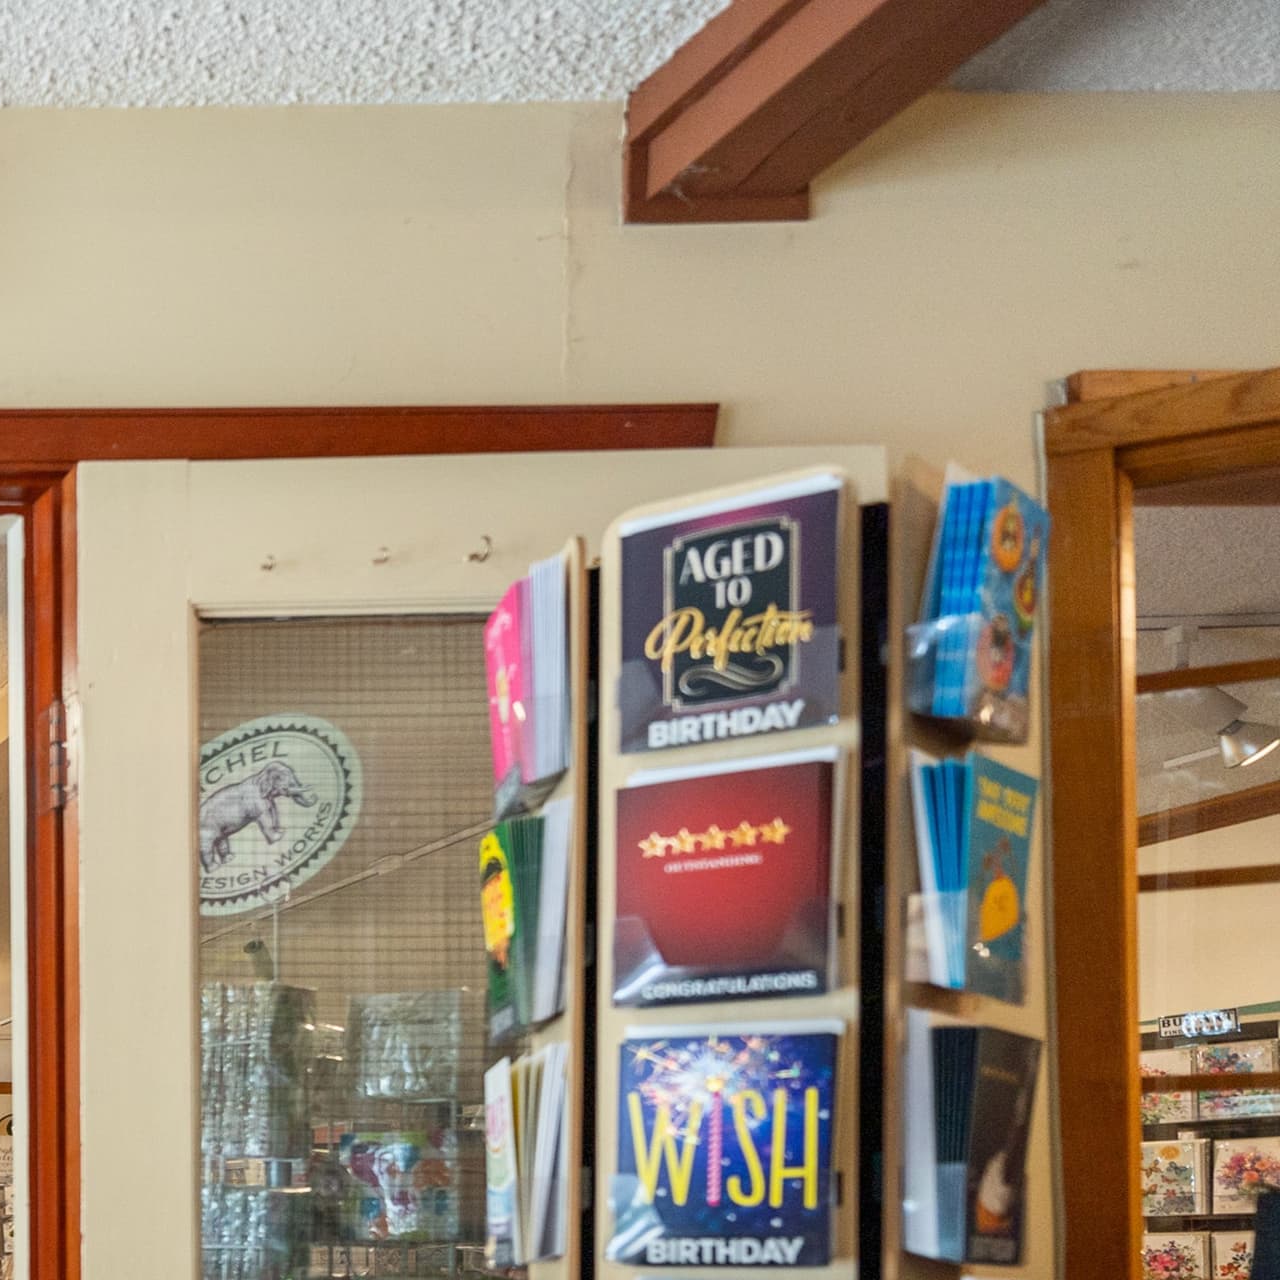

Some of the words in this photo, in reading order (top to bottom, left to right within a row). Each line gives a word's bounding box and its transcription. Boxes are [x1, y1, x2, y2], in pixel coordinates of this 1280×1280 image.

[680, 531, 784, 586] AGED
[644, 601, 815, 673] Perfection
[648, 699, 806, 748] BIRTHDAY
[200, 740, 289, 794] CHEL
[200, 866, 268, 890] ESIGN
[275, 801, 332, 866] WORKS
[642, 970, 818, 999] CONGRATULATIONS
[627, 1087, 819, 1210] WISH
[647, 1236, 805, 1265] BIRTHDAY
